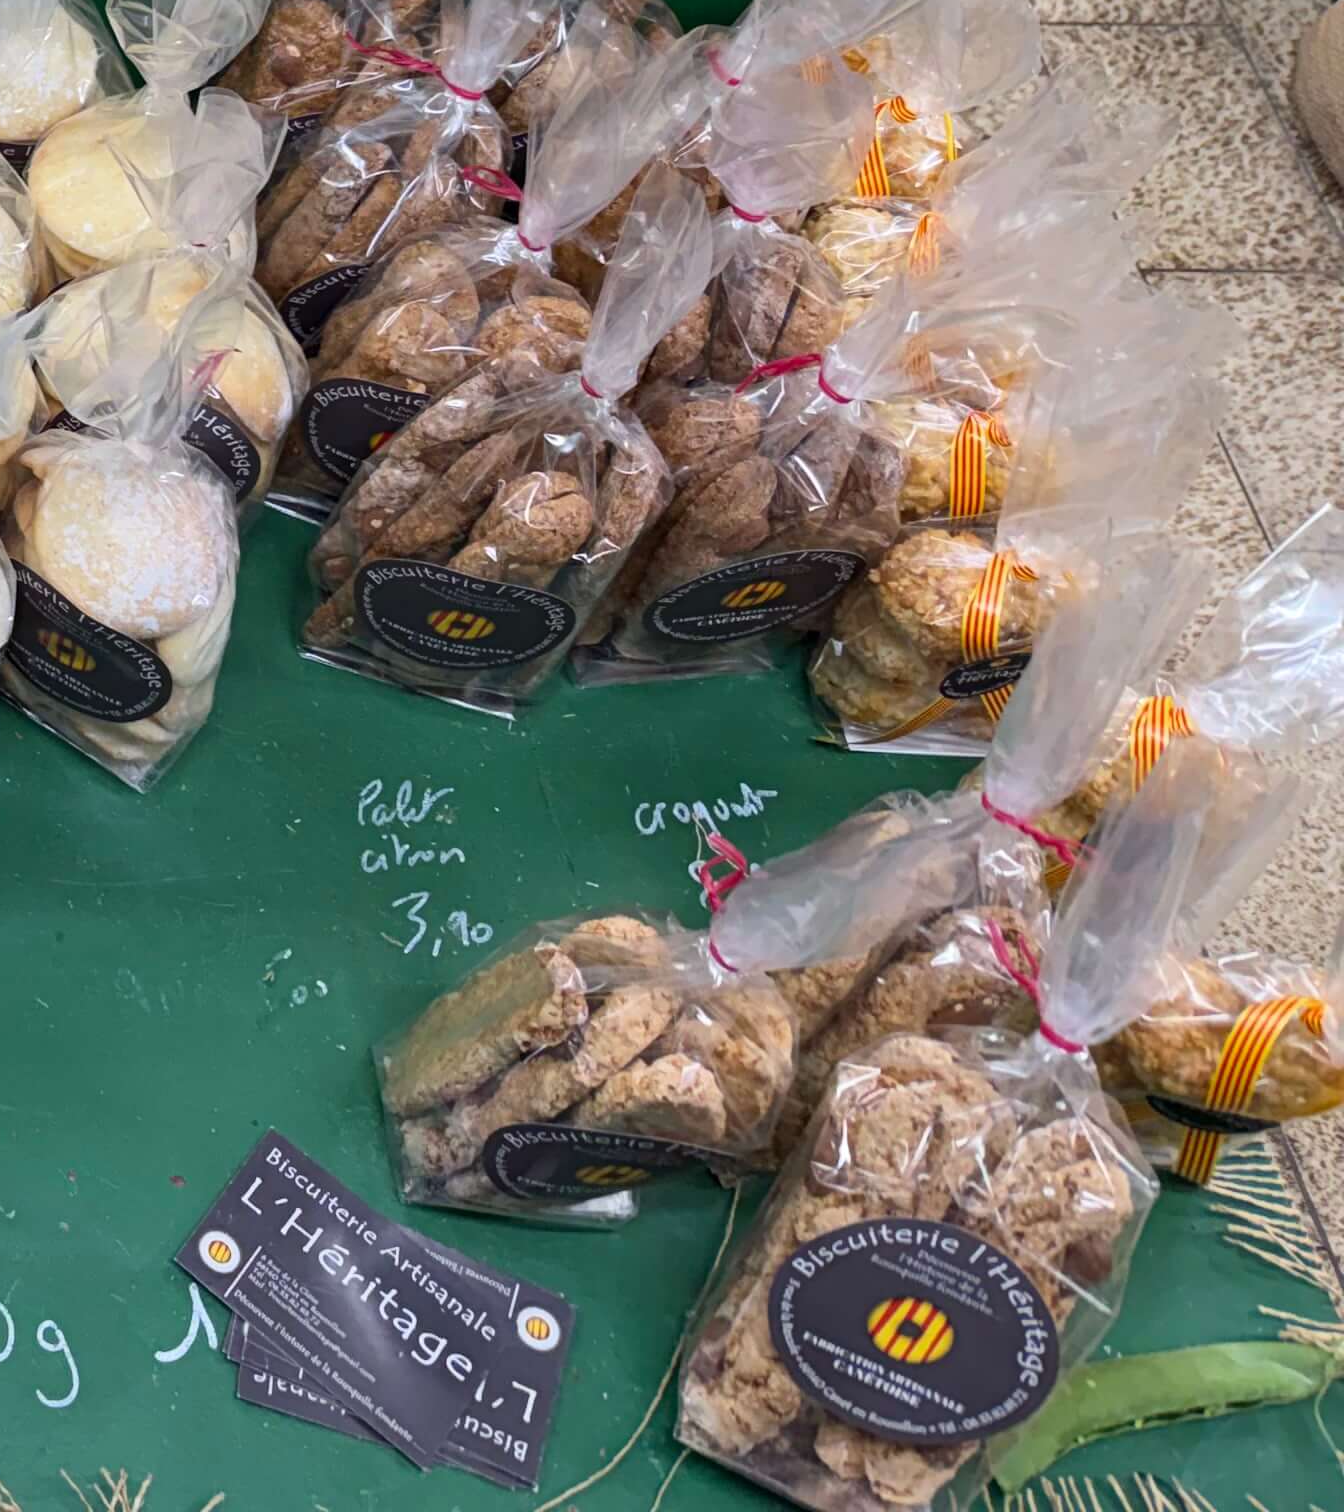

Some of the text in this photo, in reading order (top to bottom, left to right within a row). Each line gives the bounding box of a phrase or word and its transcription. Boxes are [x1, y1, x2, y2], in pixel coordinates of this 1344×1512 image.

[239, 1175, 475, 1384] L'Héritage
[264, 1146, 379, 1247] Biscuiterie
[379, 1242, 498, 1343] Artisanale
[792, 1222, 1050, 1388] Biscuiterie l'Héritage
